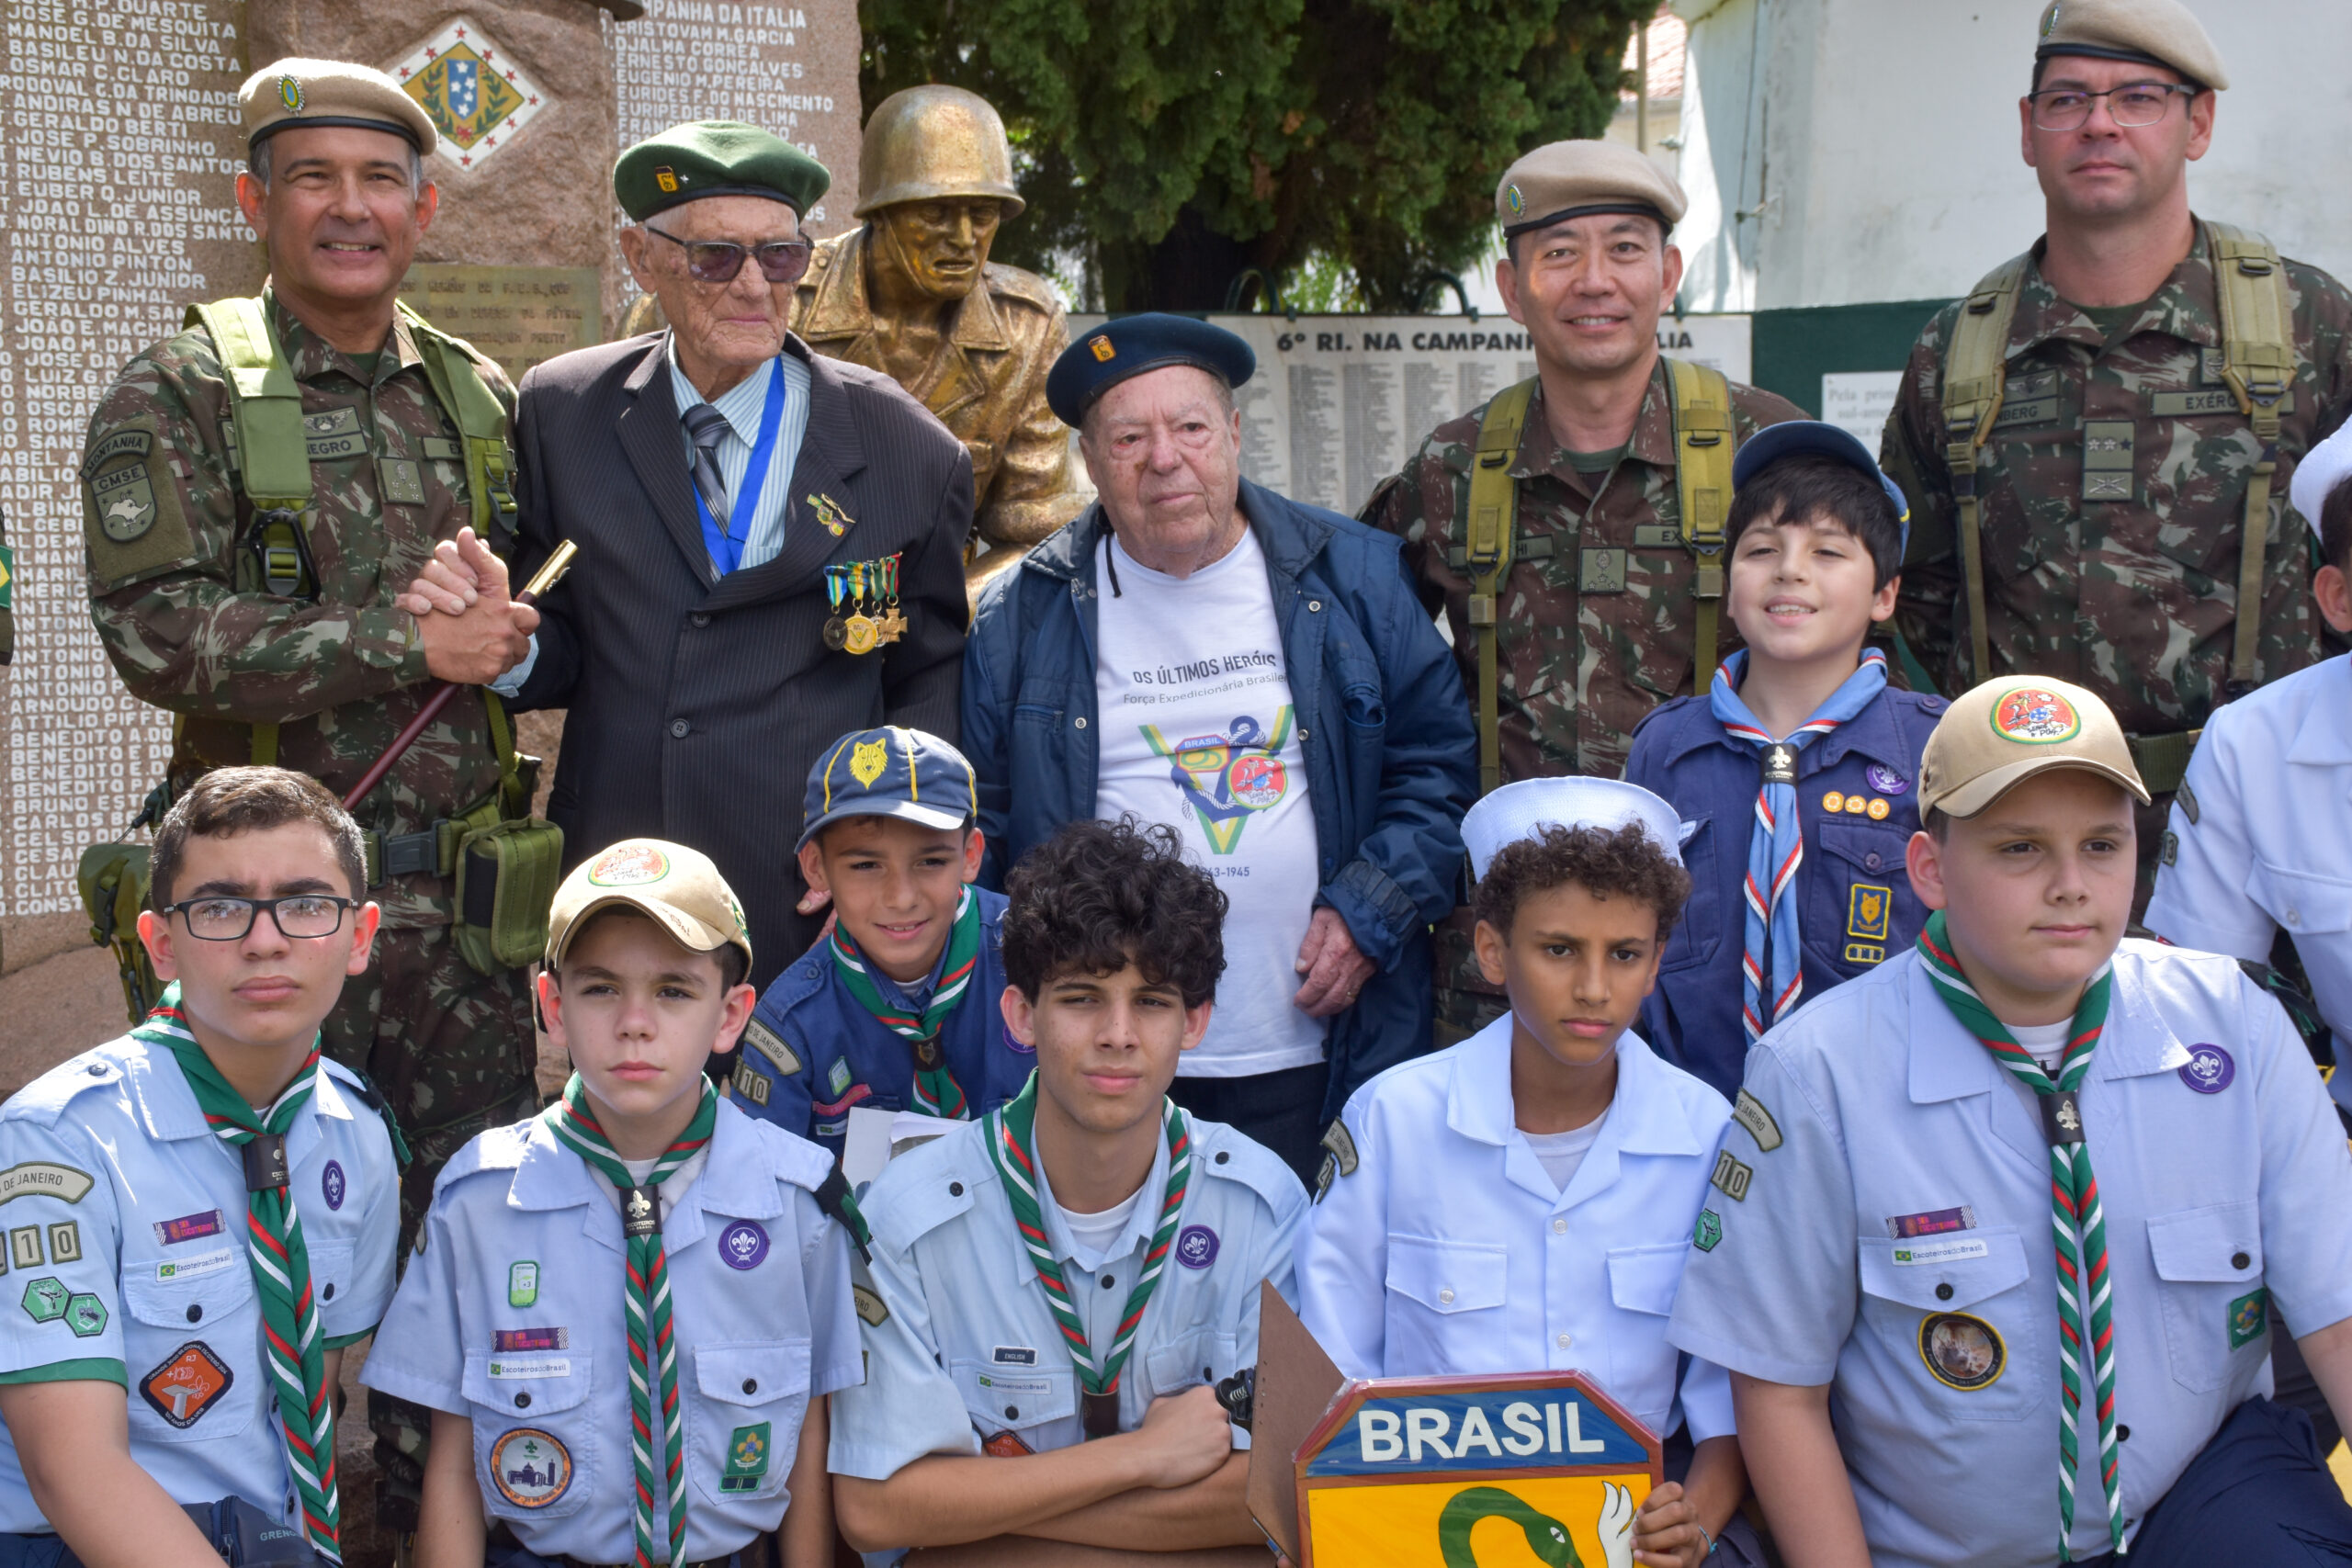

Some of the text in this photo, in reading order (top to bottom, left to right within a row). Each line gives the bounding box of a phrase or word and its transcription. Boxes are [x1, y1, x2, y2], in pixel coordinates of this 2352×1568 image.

[7, 6, 66, 24] JOSE
[131, 17, 237, 39] MESQUITA
[718, 4, 806, 28] DA ITALIA
[7, 22, 96, 44] MANOEL
[161, 35, 220, 54] SILVA
[615, 22, 713, 40] CRISTOVAM
[9, 39, 106, 62] BASILEU
[170, 53, 242, 73] COSTA
[615, 36, 760, 59] DJALMA CORREA
[10, 58, 86, 77] OSMAR
[616, 53, 803, 78] ERNESTO GONÇALVES
[617, 69, 691, 87] EUGENIO
[144, 85, 240, 107] TRINDADE
[617, 85, 688, 103] EURIDES
[734, 94, 833, 112] NASCIMENTO
[14, 93, 111, 116] ANDIRAS
[139, 102, 164, 119] DE
[172, 106, 243, 125] ABREU
[617, 101, 716, 120] EURIPEDES
[761, 110, 798, 127] LIMA
[126, 119, 188, 138] BERTI
[17, 146, 83, 165] NEVIO
[161, 155, 247, 175] SANTOS
[17, 163, 175, 187] RUBENS LEITE
[18, 181, 94, 200] EUBER
[17, 214, 128, 235] NORALDINO
[11, 232, 185, 254] ANTONIO ALVES
[11, 249, 192, 272] ANTONIO PINTON
[12, 265, 98, 285] BASILIO
[13, 283, 175, 304] ELIZEU PINHAL
[14, 300, 119, 319] GERALDO
[16, 335, 75, 353] JOAO
[1317, 333, 1351, 352] RI.
[1363, 333, 1402, 352] NA
[24, 353, 83, 368] JOSE
[90, 354, 119, 368] DA
[25, 367, 75, 384] LUIZ
[1, 451, 59, 467] ABEL
[87, 437, 142, 472] MONTANHA
[0, 467, 76, 483] ABILIO
[98, 467, 141, 491] CMSE
[2, 484, 54, 500] ADIR
[2, 502, 84, 516] ALBINO
[9, 664, 106, 681] ANTONIO
[1133, 649, 1277, 685] OS ÚLTIMOS HERÓIS
[10, 680, 107, 697] ANTONIO
[1124, 672, 1287, 706] Força Expedicionária Brasilei
[10, 696, 115, 715] ARNOUDO
[11, 714, 98, 731] ATTILIO
[11, 728, 123, 748] BENEDITO
[1184, 737, 1221, 749] BRASIL
[11, 745, 123, 765] BENEDITO
[11, 761, 124, 781] BENEDITO
[13, 779, 125, 798] BENEDITO
[14, 796, 88, 815] BRUNO
[14, 812, 104, 830] CARLOS
[14, 829, 90, 847] CELSO
[759, 1034, 784, 1059] JANEIRO
[1742, 1105, 1766, 1132] JANEIRO
[4, 1173, 63, 1191] DE JANEIRO
[187, 1354, 197, 1362] RJ
[1359, 1402, 1605, 1462] BRASIL
